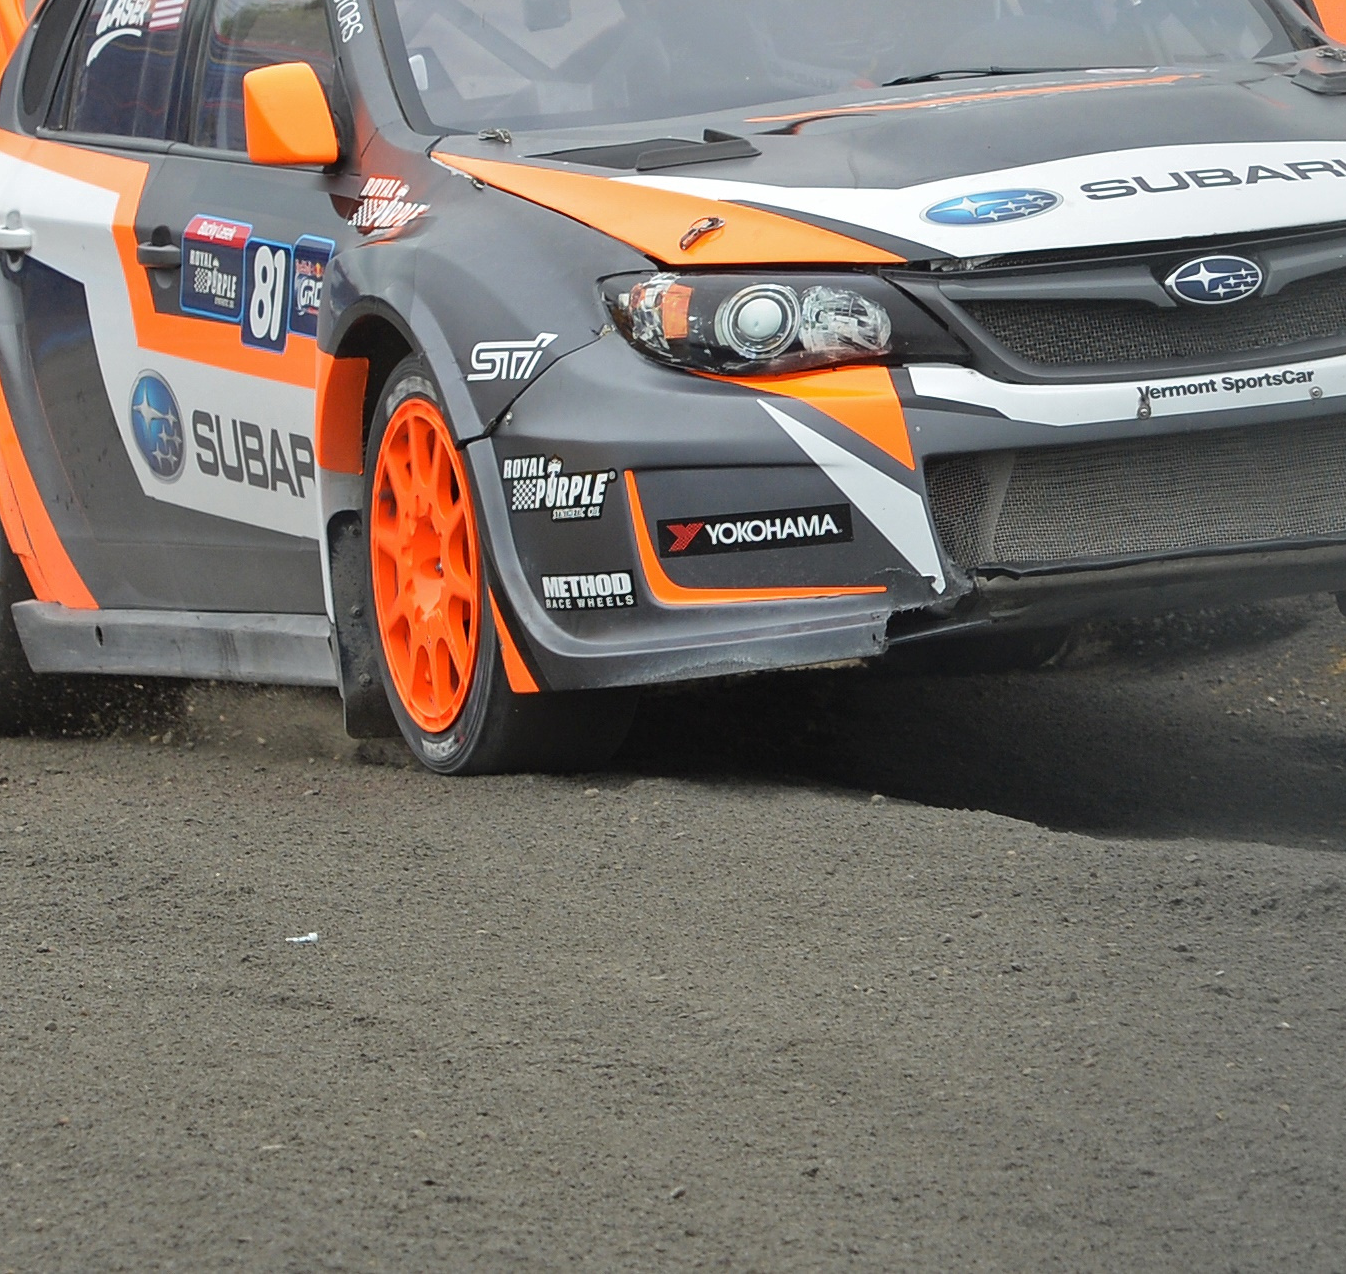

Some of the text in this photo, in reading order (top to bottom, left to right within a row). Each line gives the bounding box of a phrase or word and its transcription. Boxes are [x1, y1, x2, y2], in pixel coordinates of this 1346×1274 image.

[189, 249, 213, 269] ROYAL
[205, 268, 237, 299] PURPLE
[249, 245, 286, 342] 81
[1137, 370, 1315, 401] Vermont SportsCar
[192, 409, 316, 498] SUBAR
[503, 456, 546, 479] ROYAL
[534, 472, 609, 509] PURPLE
[706, 513, 838, 546] YOKOHAMA
[541, 572, 632, 598] METHOD
[545, 594, 635, 609] RACE WHEELS
